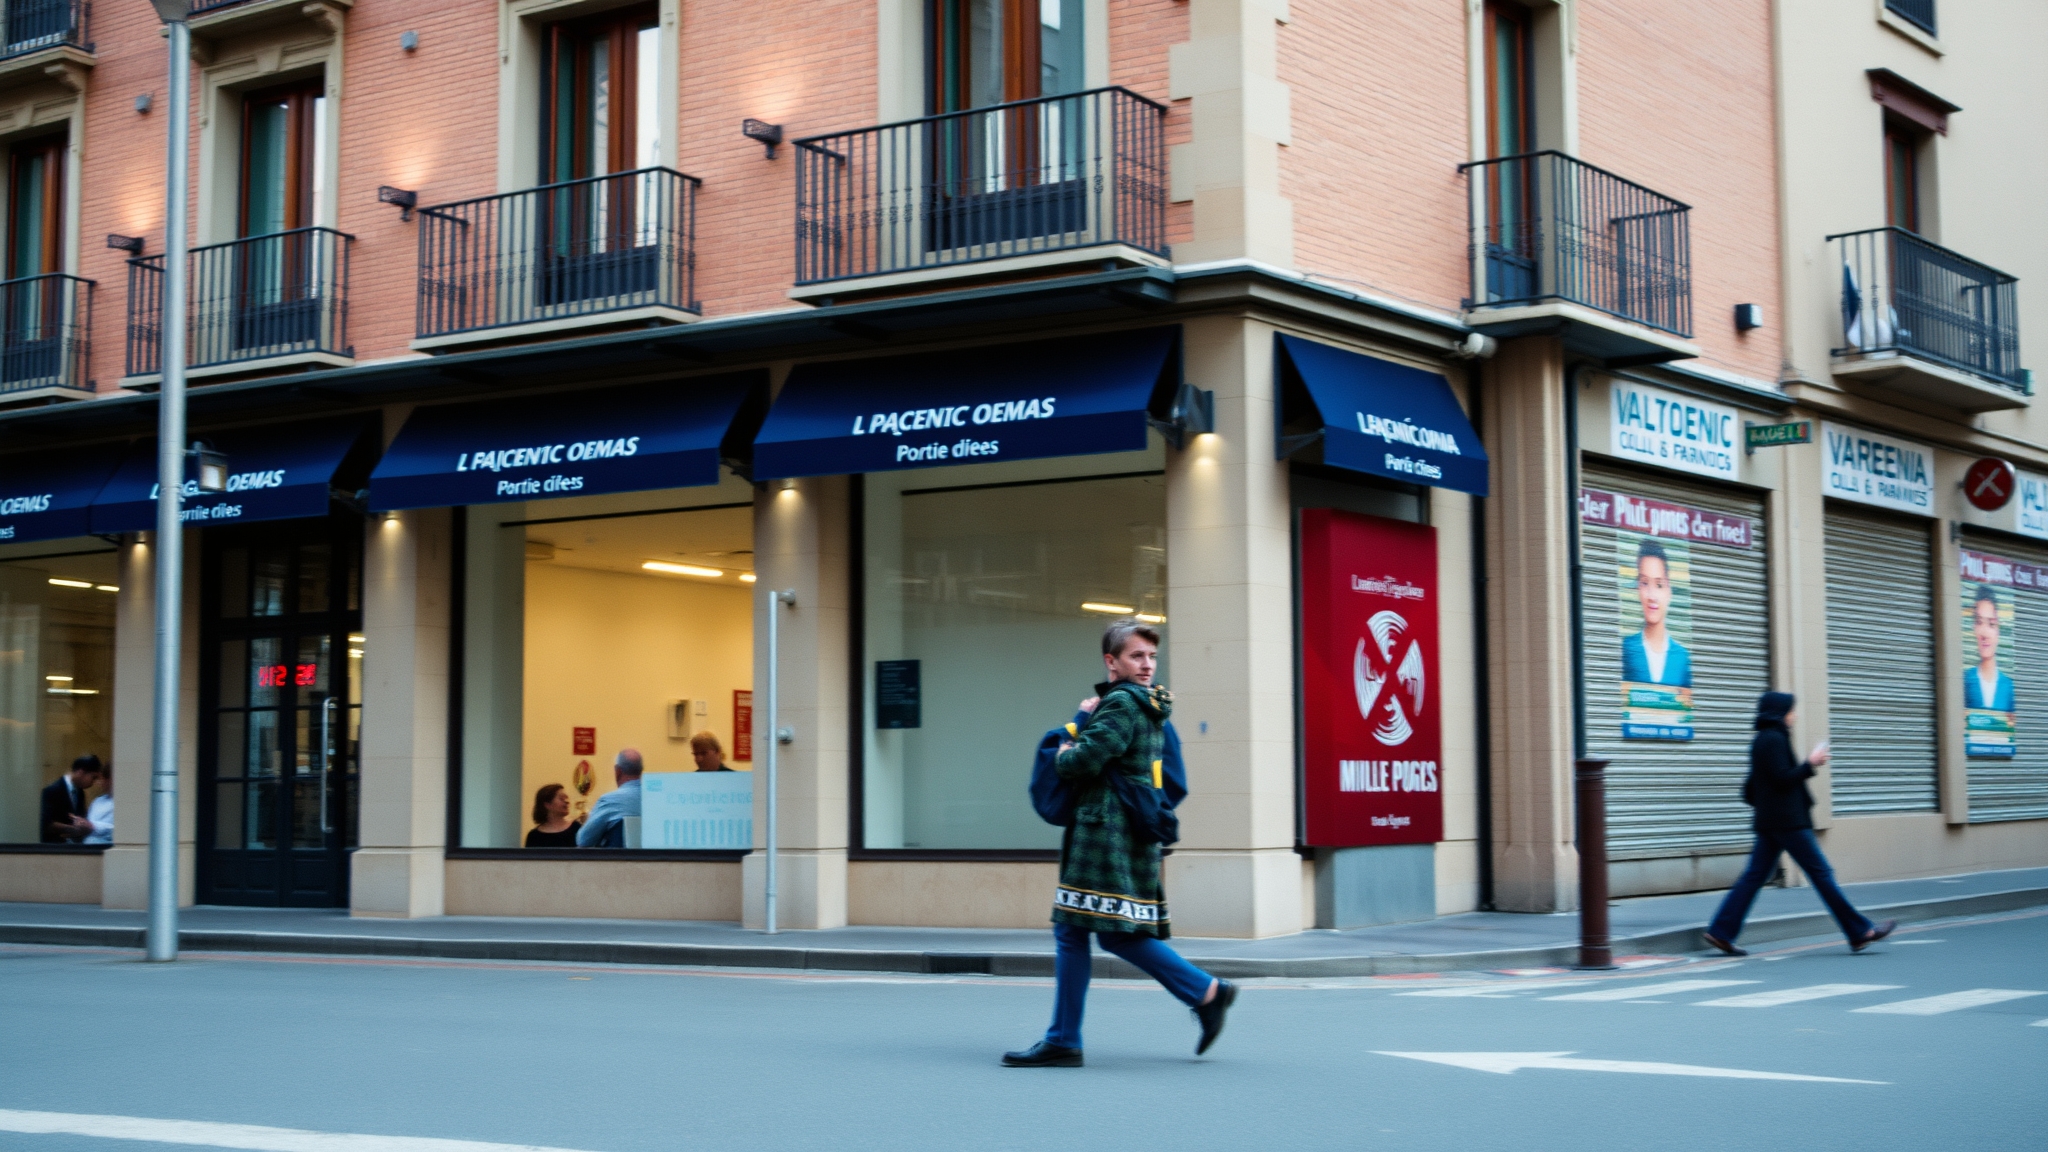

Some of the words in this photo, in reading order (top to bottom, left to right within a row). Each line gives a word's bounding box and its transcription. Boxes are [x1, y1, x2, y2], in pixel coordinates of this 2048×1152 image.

[972, 397, 1056, 425] OEMAS
[567, 436, 640, 462] OEMAS
[896, 443, 949, 462] Portie
[226, 469, 286, 493] OEMAS
